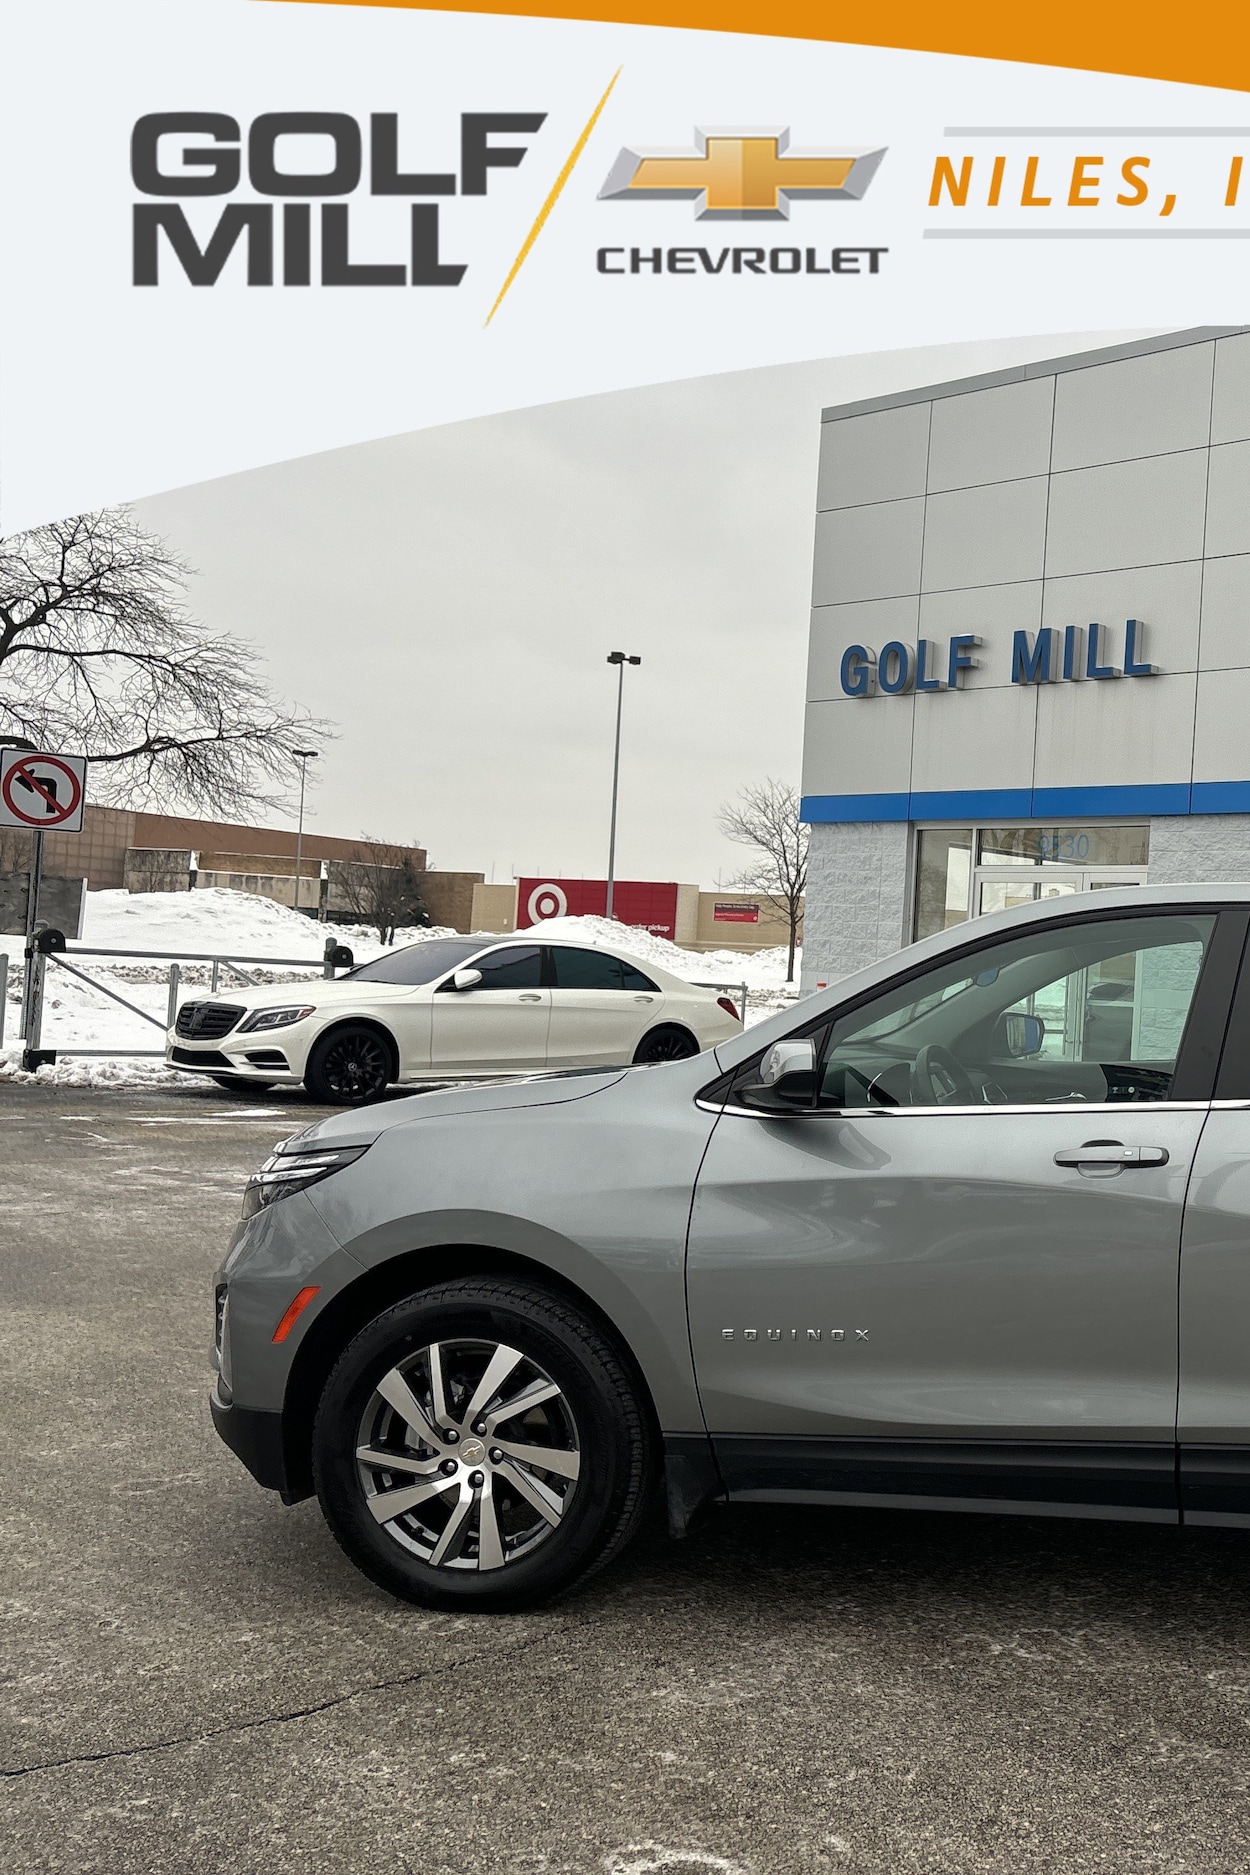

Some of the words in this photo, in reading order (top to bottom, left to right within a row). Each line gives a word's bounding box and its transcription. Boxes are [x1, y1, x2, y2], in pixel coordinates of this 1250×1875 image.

[840, 636, 980, 697] GOLF
[1011, 619, 1157, 685] MILL
[1037, 834, 1090, 861] 9530
[721, 1328, 870, 1342] EQUINOX
